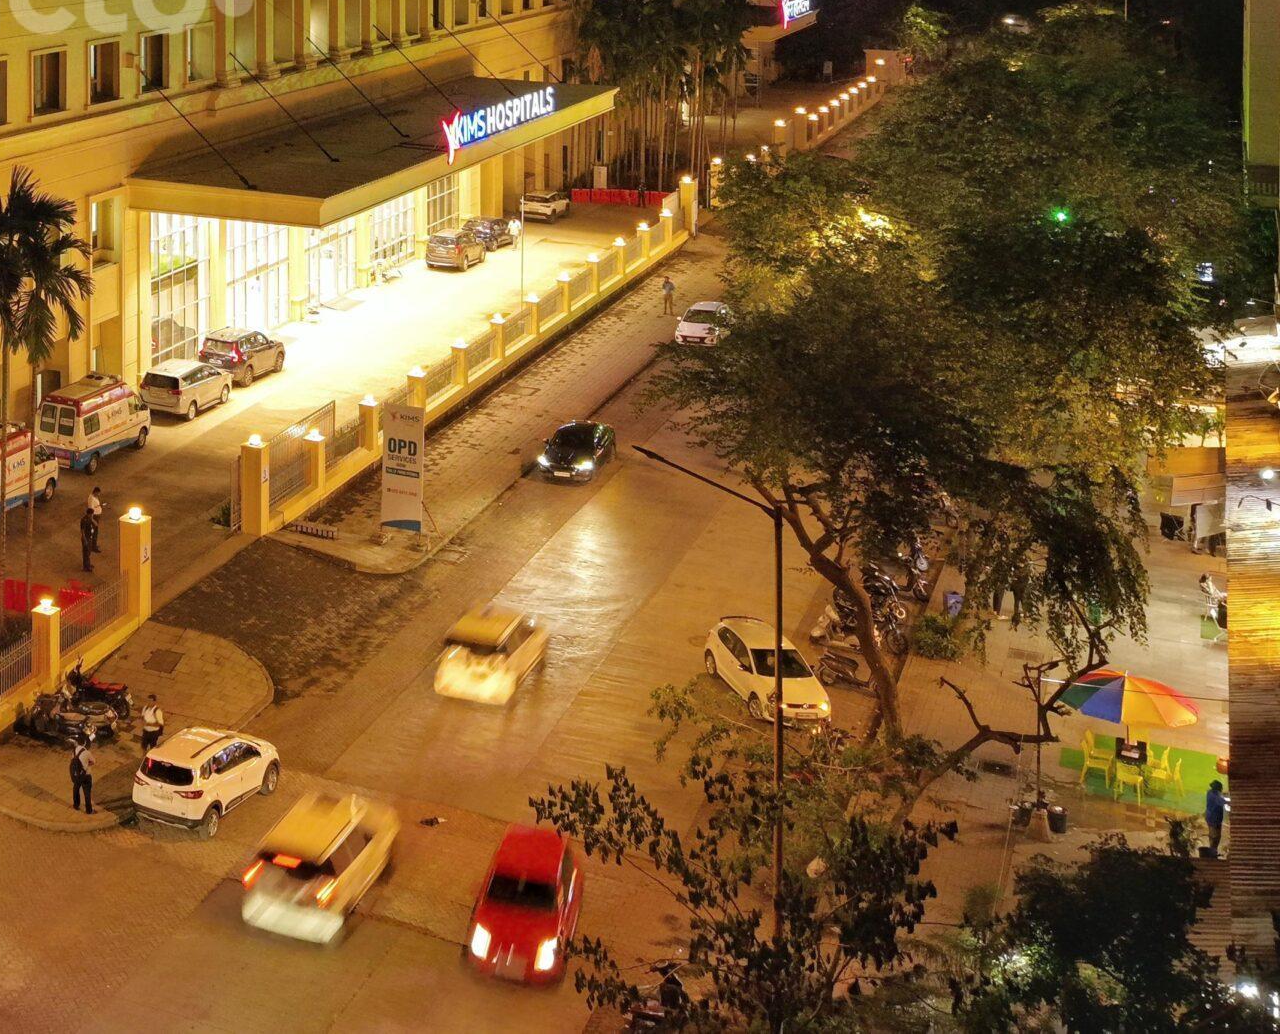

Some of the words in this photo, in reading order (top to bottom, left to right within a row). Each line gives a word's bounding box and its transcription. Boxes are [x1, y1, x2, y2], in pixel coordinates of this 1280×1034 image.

[458, 110, 486, 144] KIMS
[487, 86, 555, 134] HOSPITALS
[388, 438, 417, 456] OPD
[388, 454, 417, 464] SERVICES
